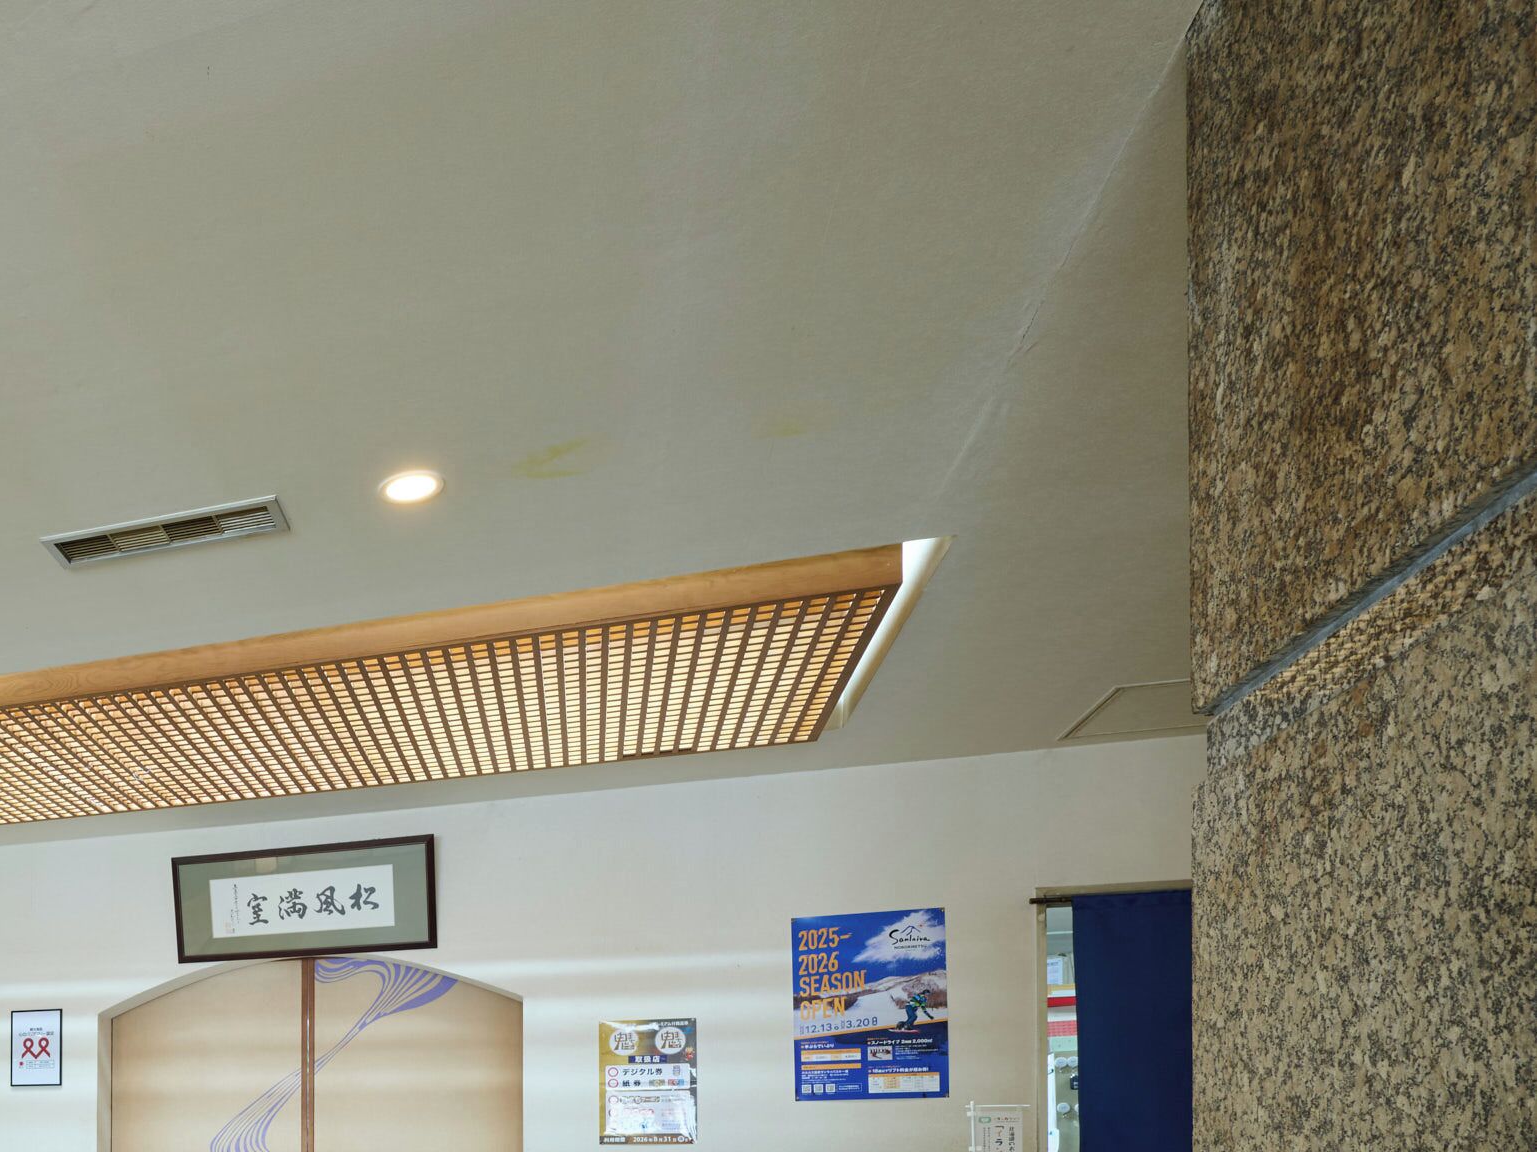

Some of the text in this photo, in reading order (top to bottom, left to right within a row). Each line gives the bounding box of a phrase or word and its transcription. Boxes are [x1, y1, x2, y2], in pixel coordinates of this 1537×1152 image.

[798, 951, 839, 975] 2026
[799, 970, 867, 998] SEASON
[800, 996, 846, 1021] OPEN
[622, 1067, 663, 1076] デジタル券
